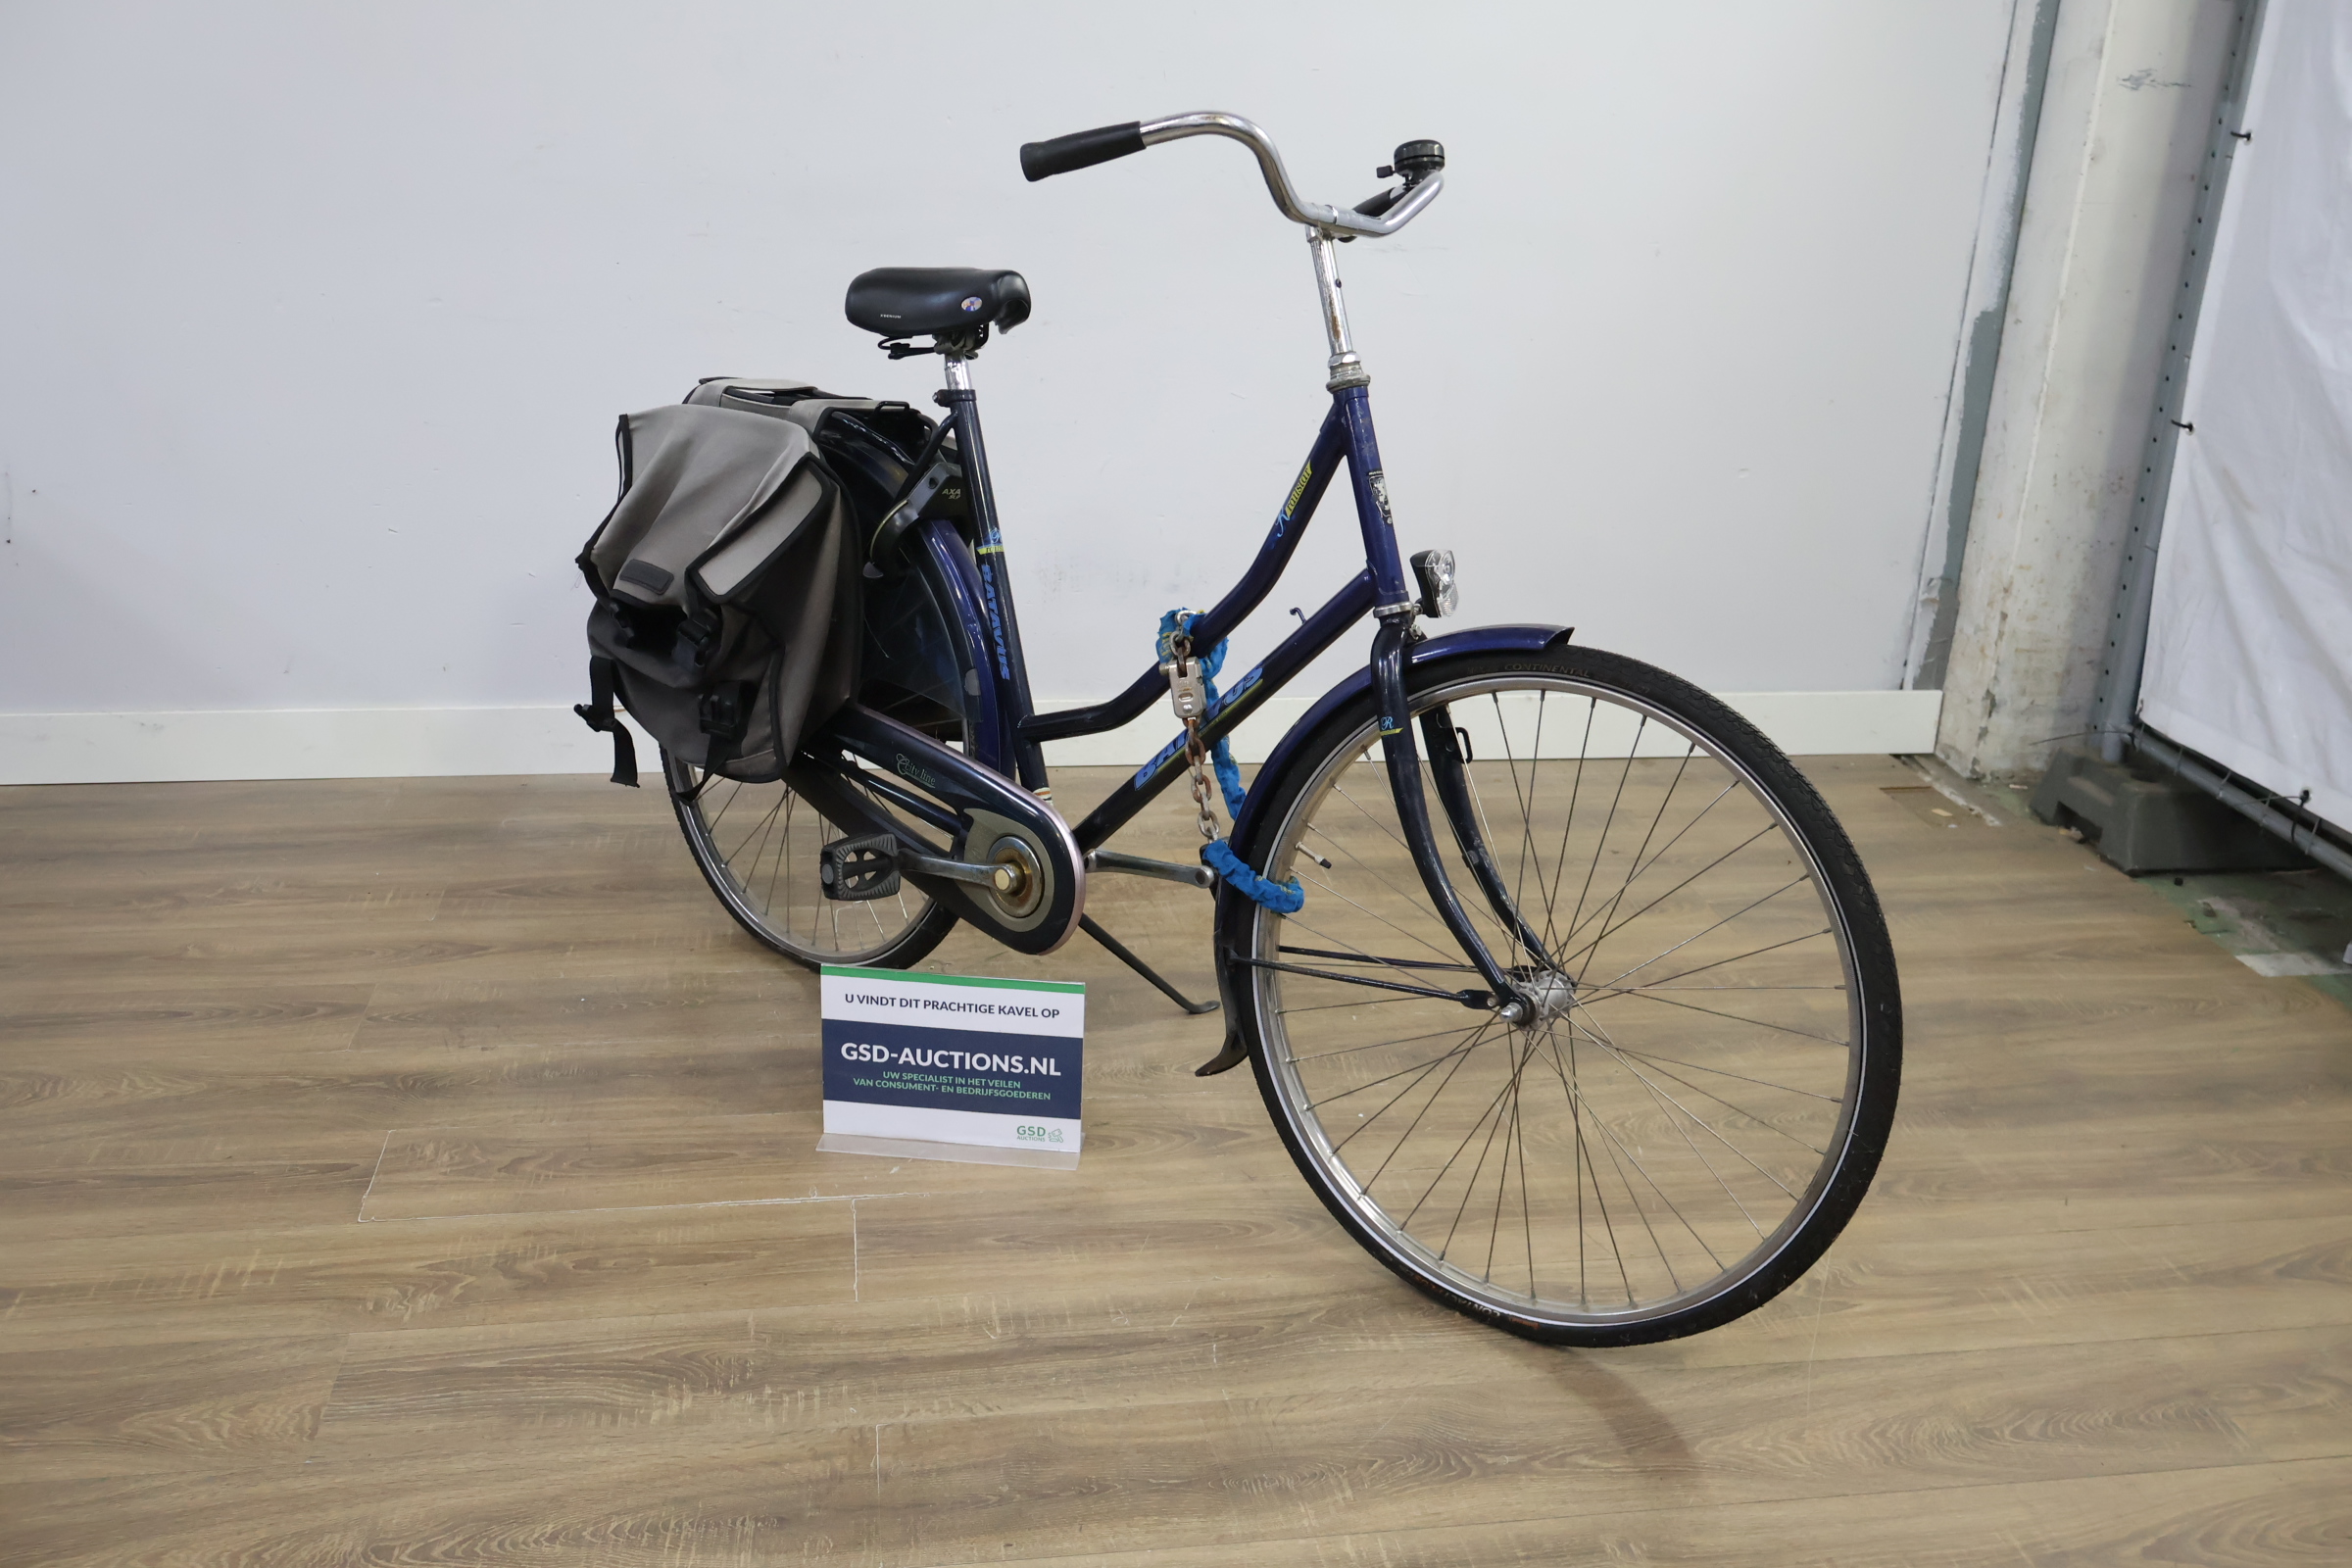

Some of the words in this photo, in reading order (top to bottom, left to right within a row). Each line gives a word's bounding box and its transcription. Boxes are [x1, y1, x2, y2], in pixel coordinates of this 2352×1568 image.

[981, 564, 1010, 680] BATAVUS
[1504, 662, 1591, 678] CONTINENTAL
[845, 993, 855, 1004] U
[857, 994, 897, 1007] VINDT
[899, 998, 921, 1008] DIT
[923, 1000, 995, 1014] PRACHTIGE
[998, 1004, 1039, 1018] KAVEL
[1041, 1007, 1060, 1019] OP
[841, 1042, 1061, 1076] GSD-AUCTIONS.NL
[853, 1077, 874, 1087] VAN
[875, 1079, 940, 1093] CONSUMENT-
[941, 1085, 955, 1094] EN
[956, 1086, 1052, 1101] BEDRIJFSGOEDEREN
[883, 1070, 901, 1080] UW
[902, 1072, 954, 1084] SPECIALIST
[955, 1076, 966, 1086] IN
[967, 1077, 987, 1087] HET
[987, 1079, 1021, 1090] VEILEN
[1016, 1125, 1047, 1138] GSD
